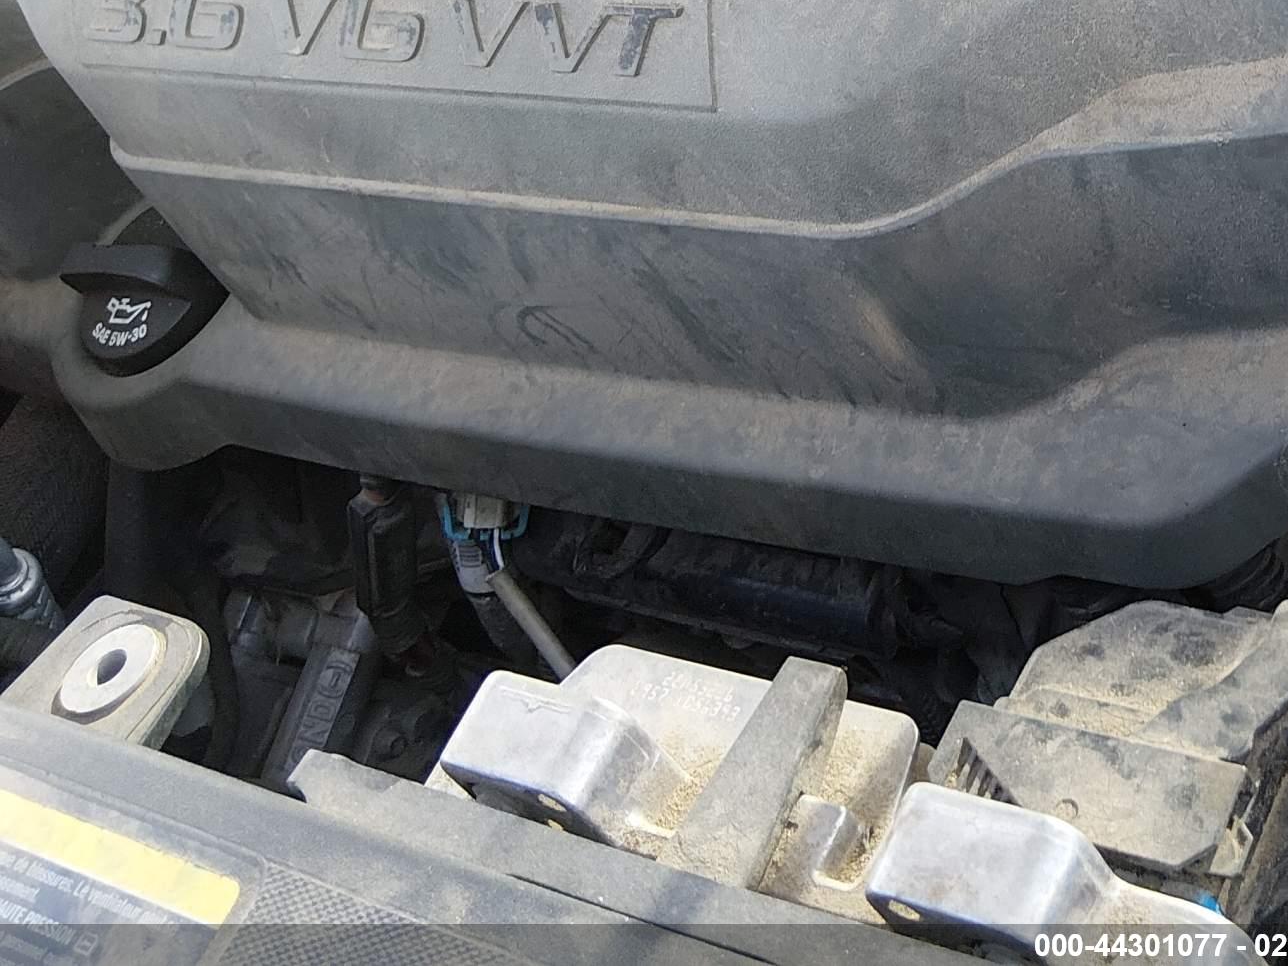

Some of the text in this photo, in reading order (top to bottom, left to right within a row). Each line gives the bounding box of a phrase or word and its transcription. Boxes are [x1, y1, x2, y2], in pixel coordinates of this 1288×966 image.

[92, 322, 148, 347] SAE 5W-30
[23, 909, 77, 946] PRESSION
